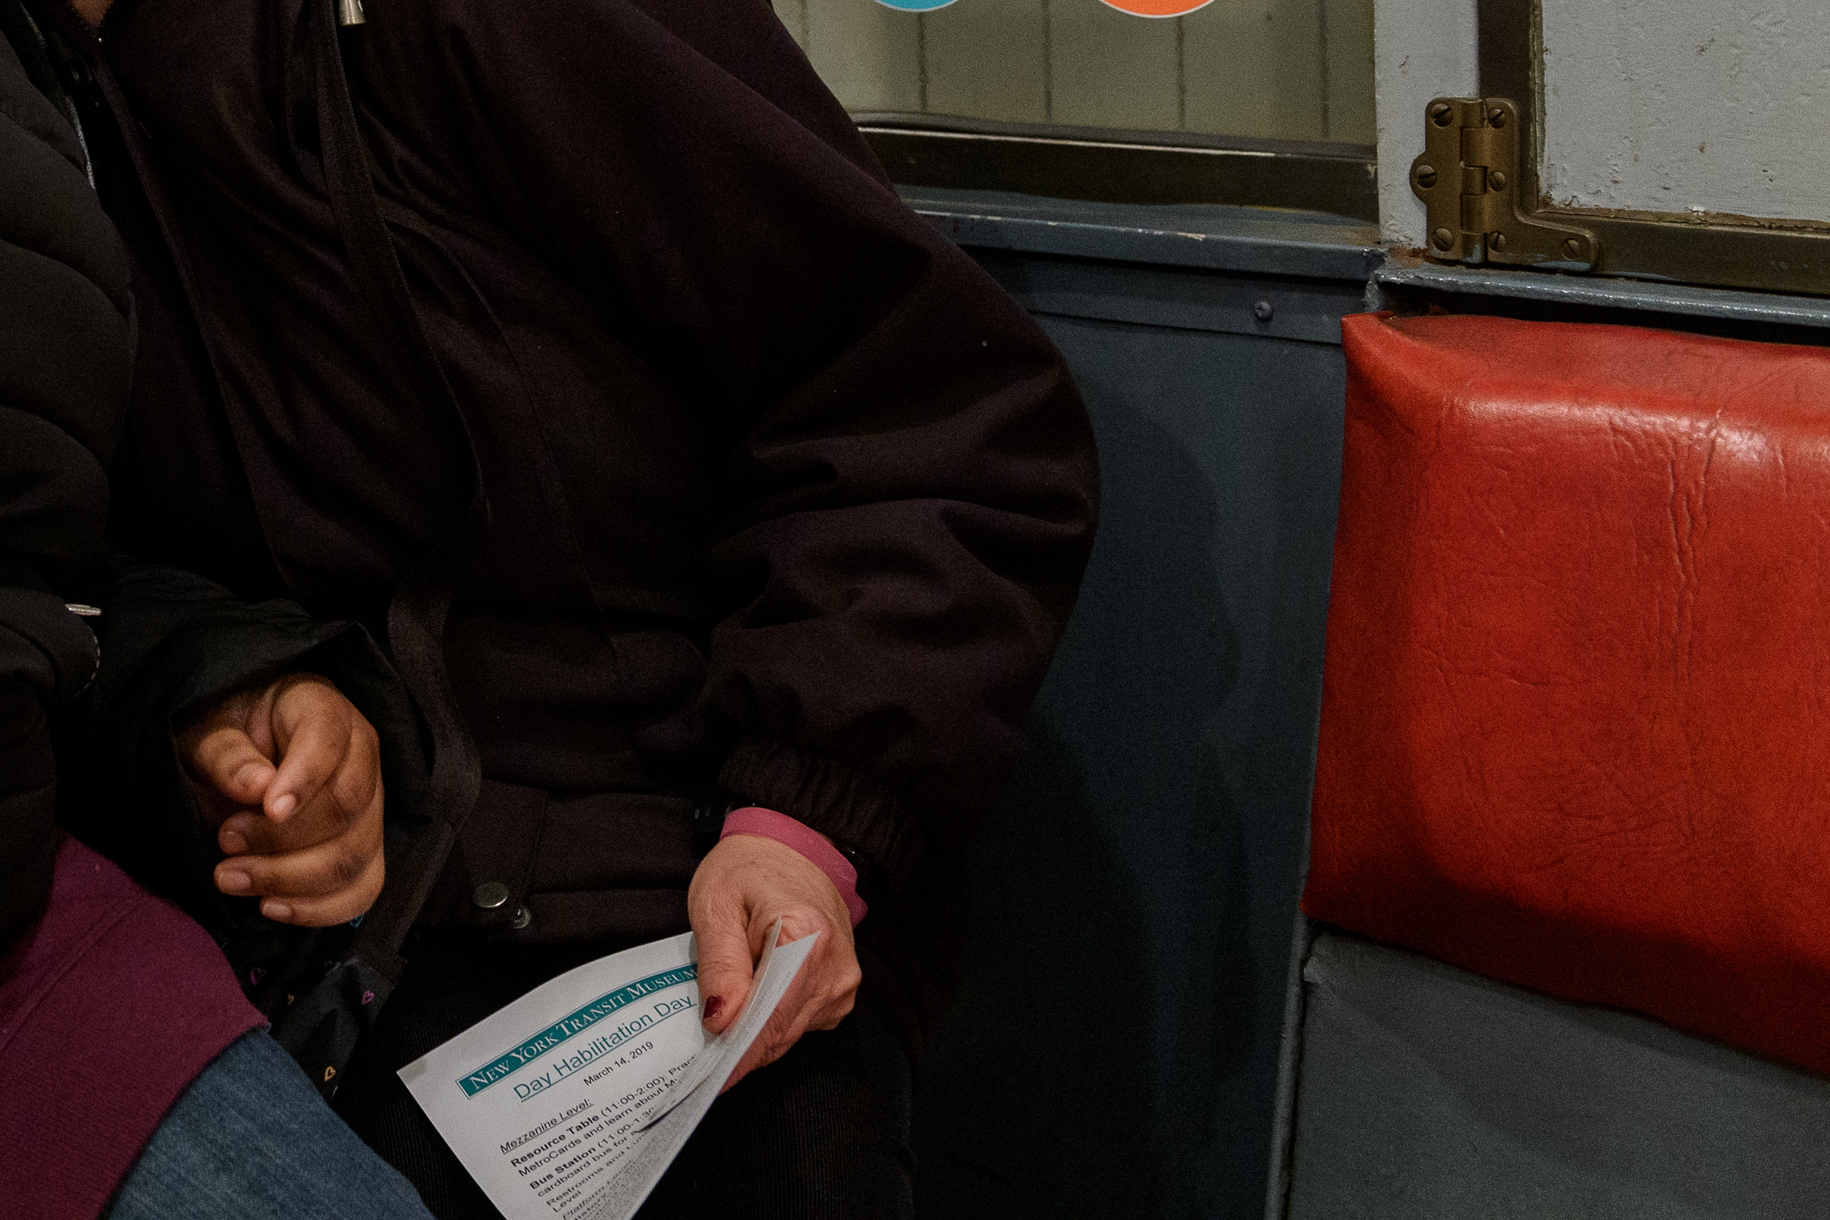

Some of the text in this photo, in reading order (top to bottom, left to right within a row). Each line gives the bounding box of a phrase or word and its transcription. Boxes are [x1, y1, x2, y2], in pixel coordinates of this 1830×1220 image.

[469, 969, 698, 1091] NEW YORK TRANSIT MUSEUM
[513, 995, 693, 1101] Day Habilitation Day
[583, 1041, 654, 1086] March 14, 2019
[499, 1098, 593, 1153] Mezzanine Level:
[510, 1133, 567, 1168] Resource
[568, 1114, 600, 1136] Table
[518, 1138, 582, 1177] MetroCards
[584, 1123, 604, 1141] and
[604, 1107, 633, 1128] learn
[634, 1087, 664, 1109] about
[529, 1172, 554, 1190] Bus
[554, 1146, 597, 1175] Station
[537, 1159, 591, 1198] cardboard
[592, 1146, 613, 1162] bus
[613, 1136, 630, 1151] for
[546, 1166, 604, 1207] Restrooms
[605, 1151, 625, 1167] and
[552, 1189, 582, 1212] Level
